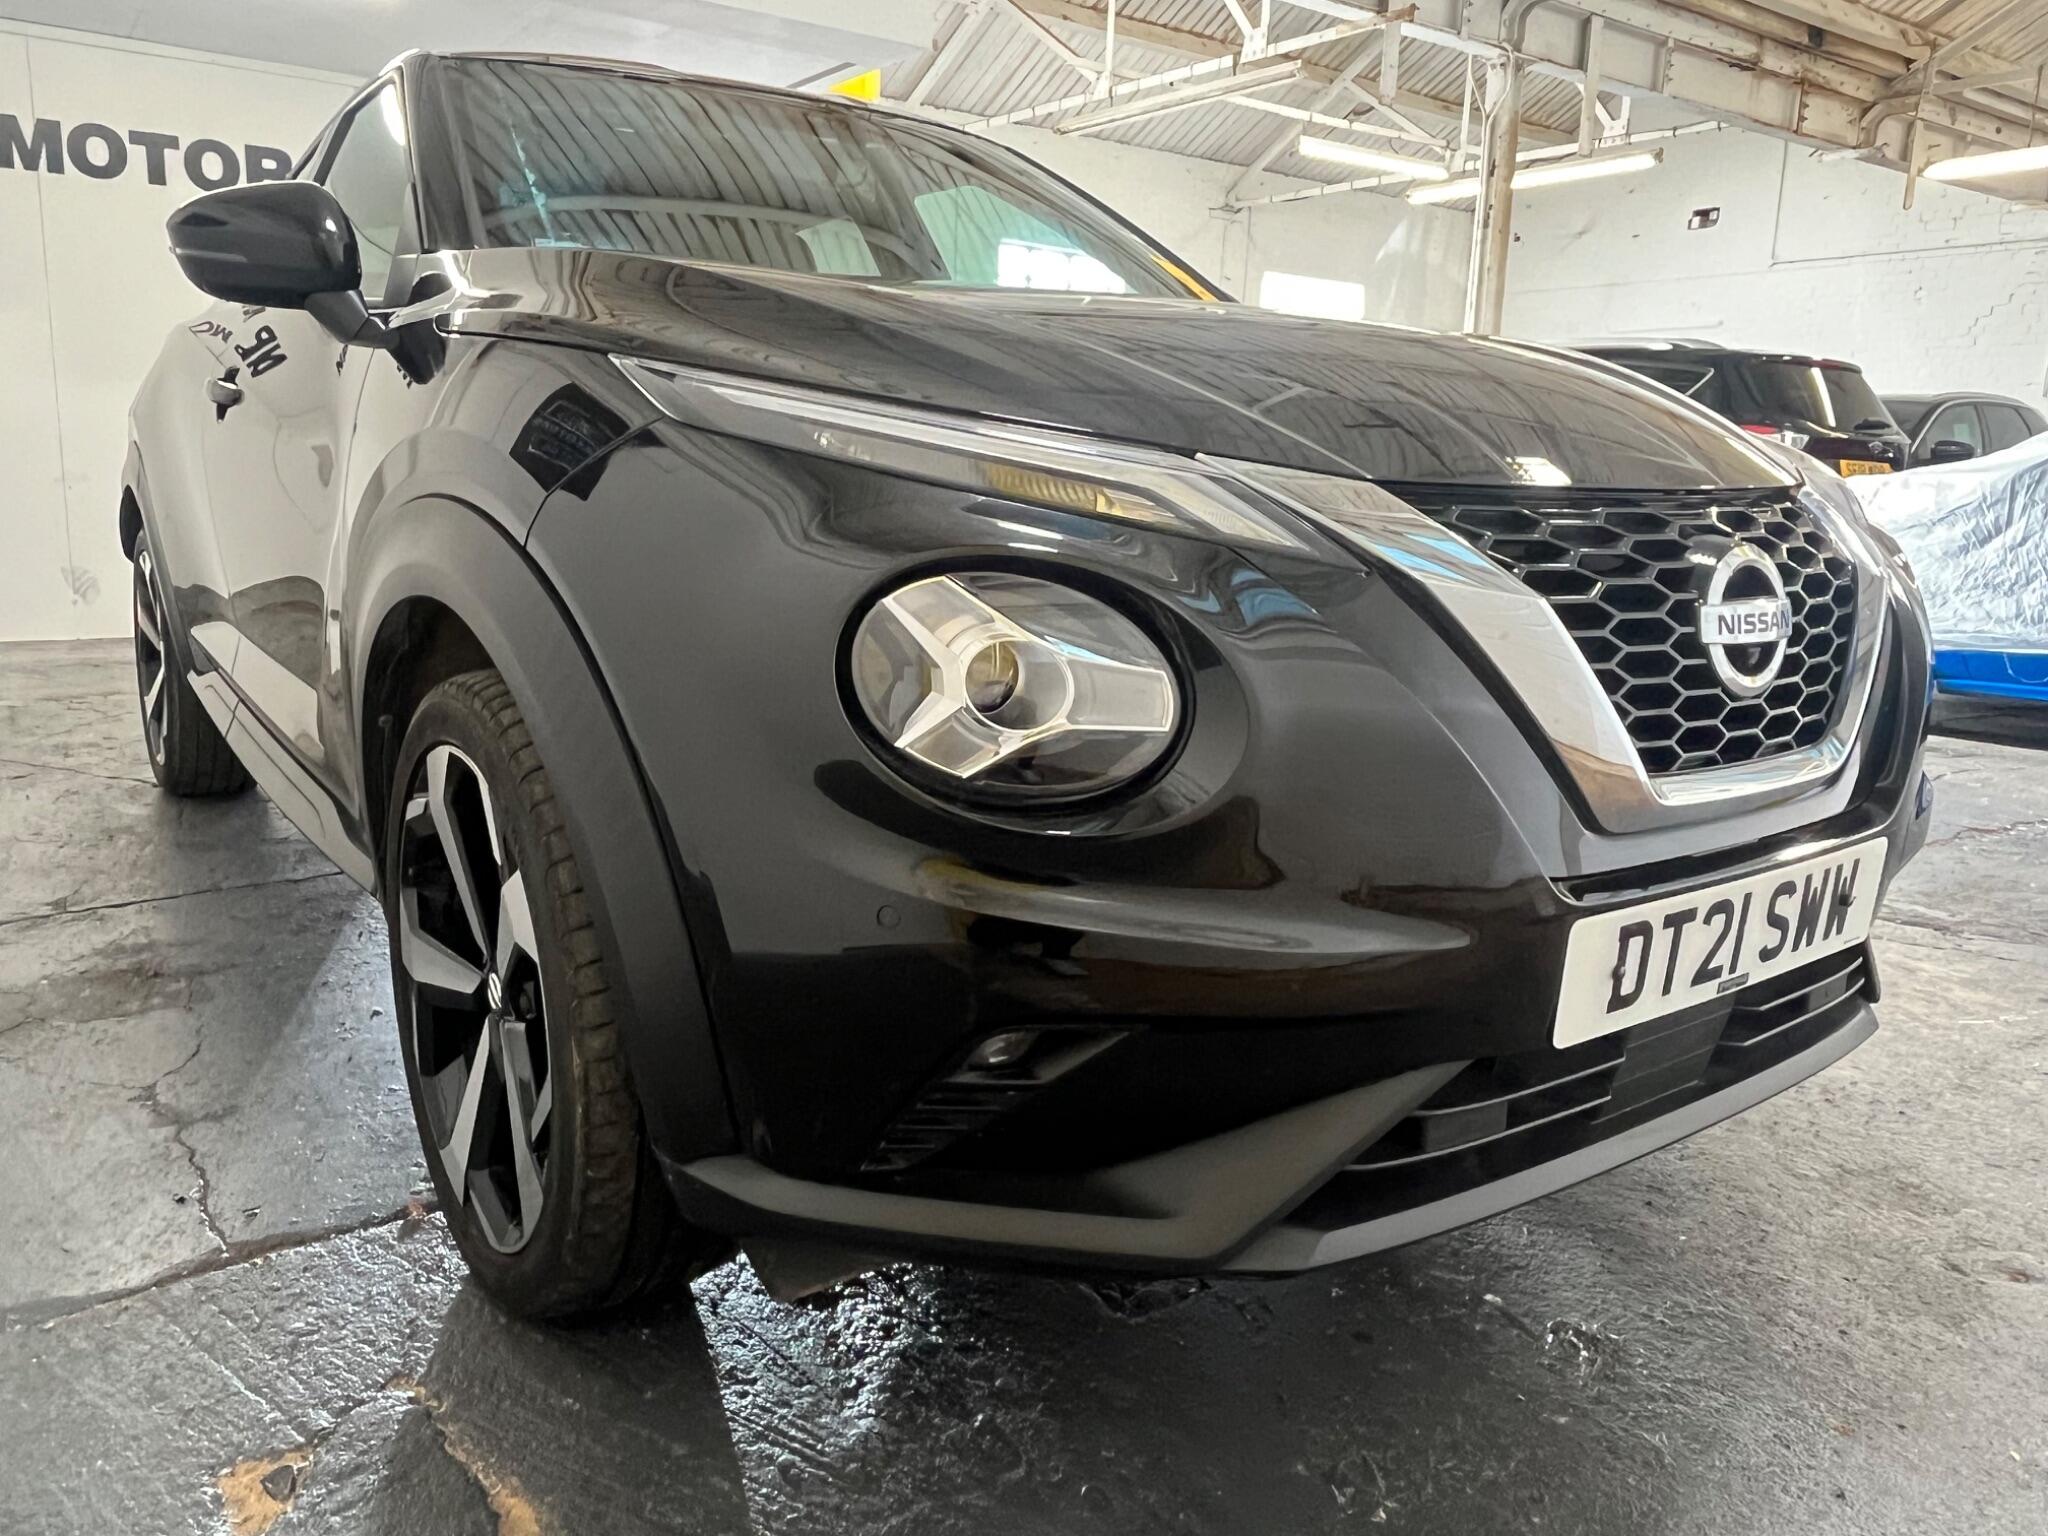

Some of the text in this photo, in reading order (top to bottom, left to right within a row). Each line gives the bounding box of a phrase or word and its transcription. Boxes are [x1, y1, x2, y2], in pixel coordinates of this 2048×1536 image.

[1717, 608, 1790, 636] NISSAN
[1605, 857, 1861, 1015] DT21 SWW
